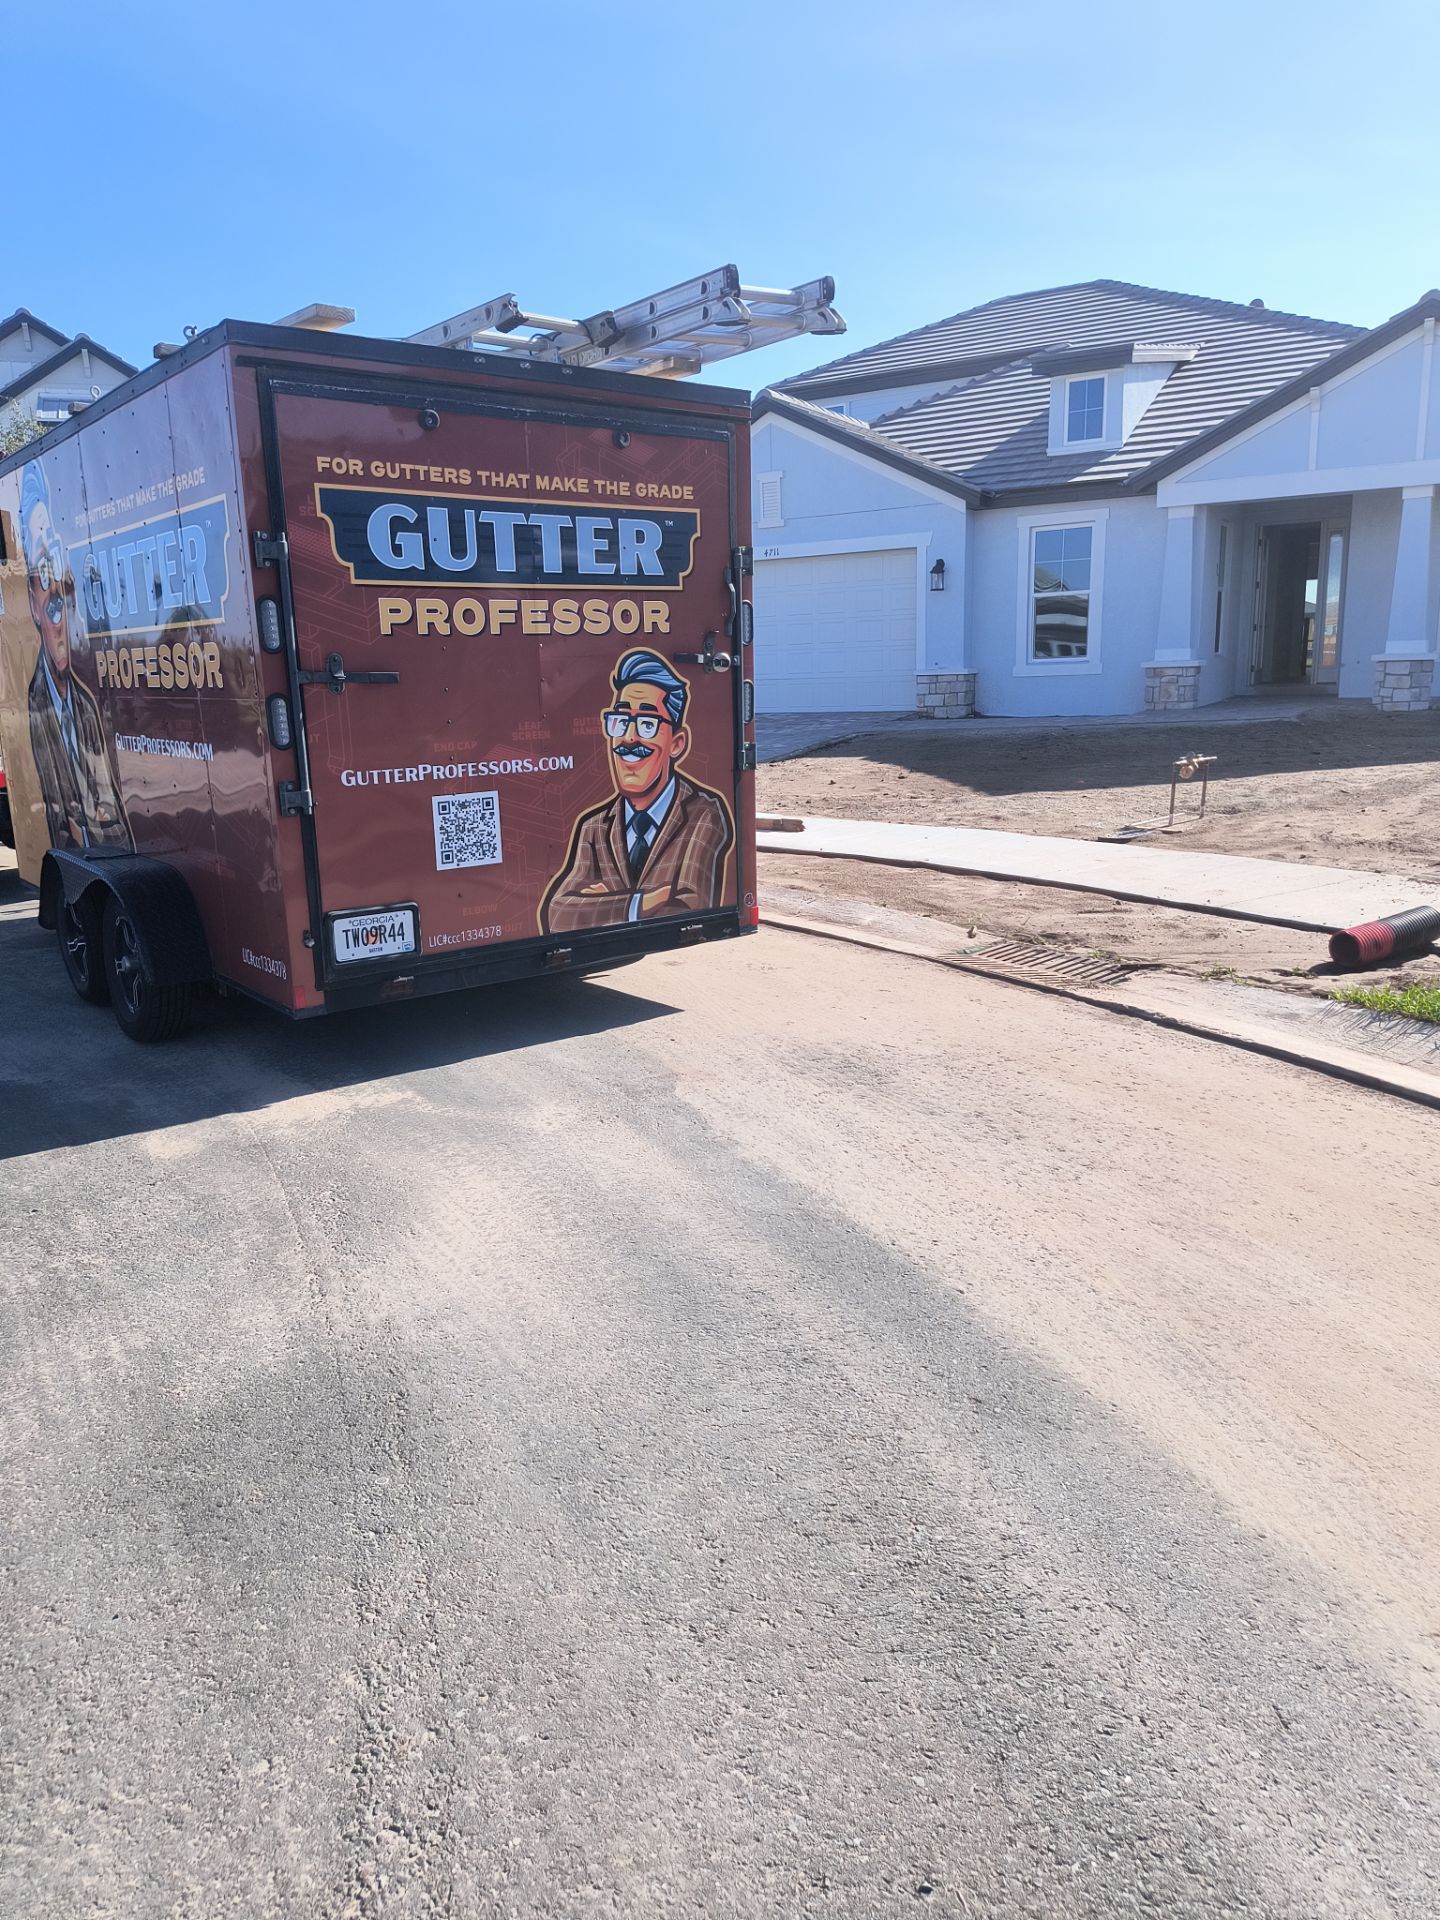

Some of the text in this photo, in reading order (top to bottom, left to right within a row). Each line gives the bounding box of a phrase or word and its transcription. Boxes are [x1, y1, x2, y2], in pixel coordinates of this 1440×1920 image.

[116, 494, 135, 514] THAT
[136, 486, 157, 506] MAKE
[157, 478, 174, 499] THE
[175, 466, 206, 492] GRADE
[316, 456, 694, 500] FOR GUTTERS THAT MAKE THE GRADE
[366, 503, 665, 577] GUTTER
[83, 524, 212, 621] GUTTER
[378, 597, 671, 637] PROFESSOR
[95, 641, 223, 689] PROFESSOR
[351, 914, 395, 927] GEORGIA
